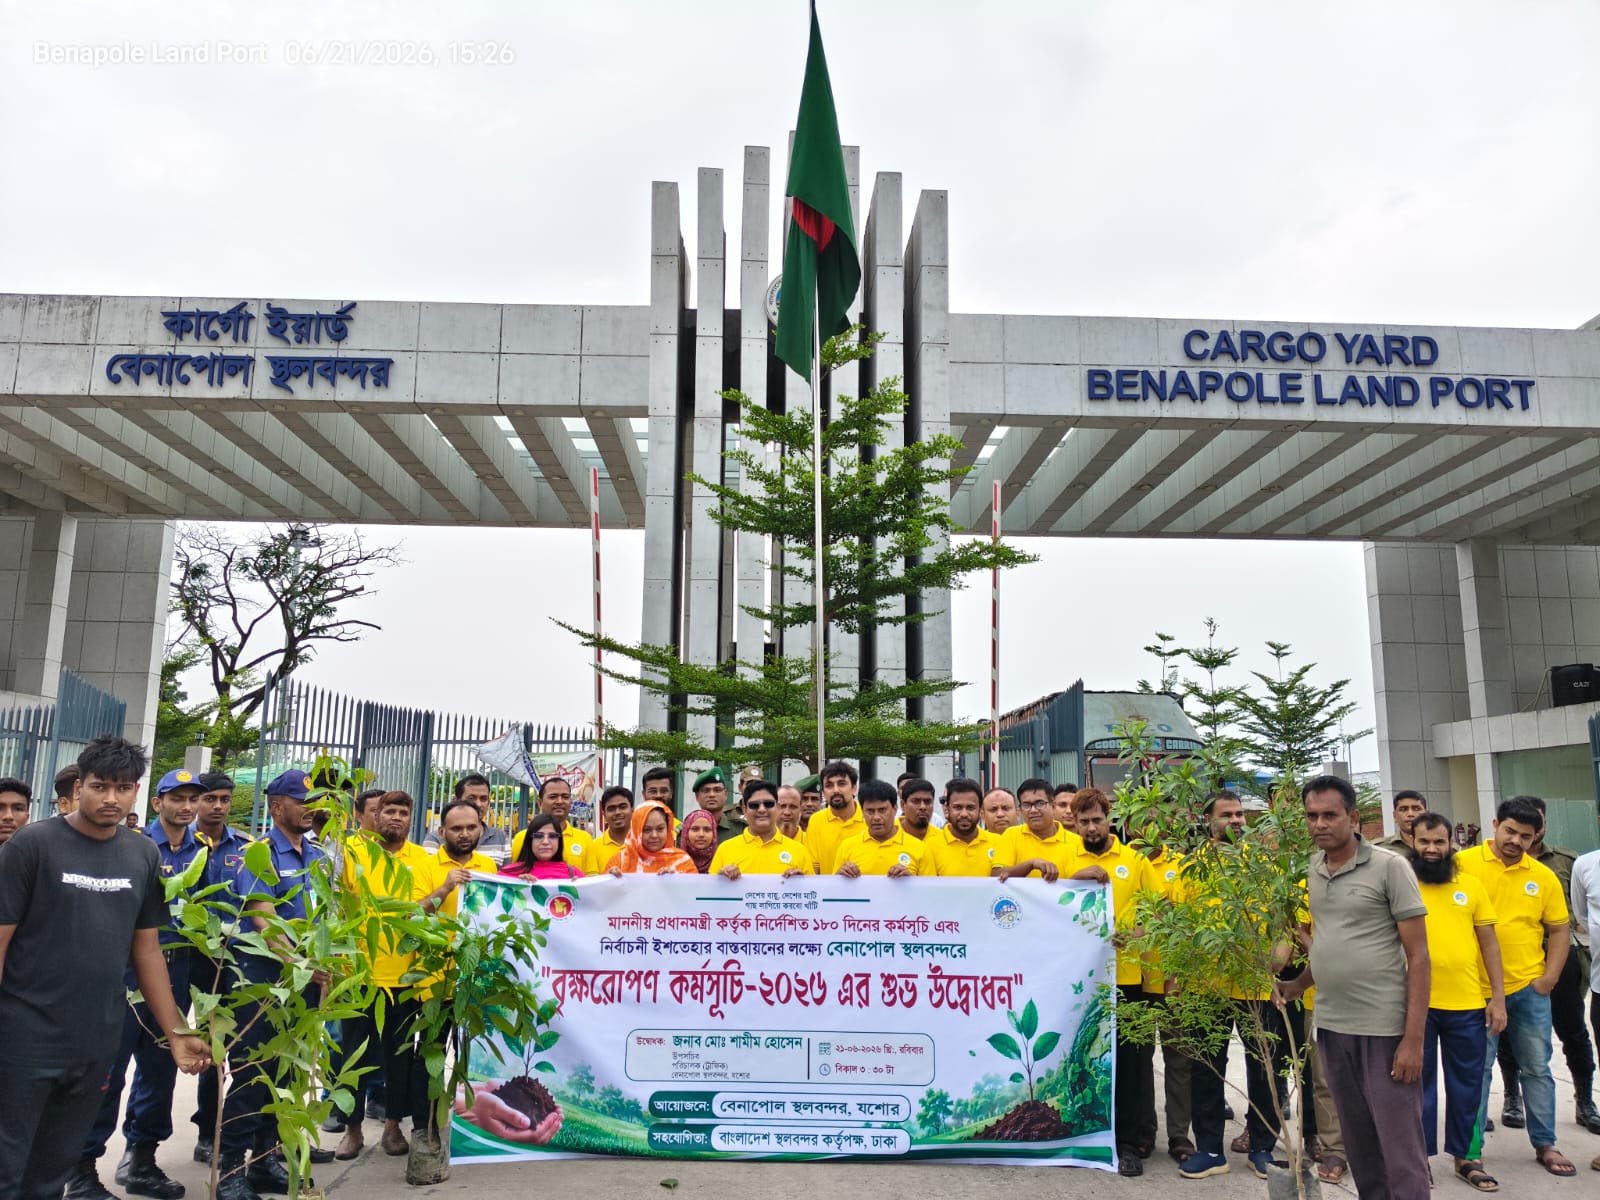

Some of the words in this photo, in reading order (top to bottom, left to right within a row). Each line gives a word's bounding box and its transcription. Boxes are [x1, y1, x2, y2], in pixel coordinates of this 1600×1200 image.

[161, 302, 255, 343] কার্গো
[264, 302, 356, 344] ইয়ার্ড
[1184, 329, 1326, 362] CARGO
[1334, 332, 1438, 366] YARD
[106, 352, 255, 387] বেনাপোল
[265, 356, 394, 394] স্থলবন্দর
[1087, 369, 1304, 404] BENAPOLE
[1315, 374, 1420, 407] LAND
[1430, 376, 1535, 410] PORT
[608, 912, 652, 930] মাননীয়
[656, 912, 712, 931] প্রধানমন্ত্রী
[716, 913, 752, 935] কর্তৃক
[755, 913, 809, 932] নির্দেশিত
[813, 919, 838, 931] ১৮০
[843, 915, 880, 933] দিনের
[884, 915, 929, 938] কর্মসূচি
[934, 919, 960, 934] এবং
[600, 936, 648, 955] নির্বাচনী
[652, 936, 712, 955] ইশতেহার
[716, 941, 784, 956] বাস্তবায়নের
[788, 942, 822, 956] লক্ষ্যে
[827, 940, 895, 957] বেনাপোল
[900, 942, 967, 960] স্থলবন্দরে
[542, 966, 660, 1017] "বৃক্ষরোপণ
[669, 958, 827, 1020] কর্মসূচি-২০২৬
[838, 972, 871, 1009] এর
[880, 972, 918, 1008] শুভ
[672, 1034, 702, 1048] জনাব
[705, 1035, 726, 1048] মোঃ
[729, 1032, 761, 1049] শামীম
[765, 1036, 803, 1049] হোসেন
[899, 1043, 924, 1056] রবিবার
[654, 1100, 709, 1113] আয়োজনে:
[720, 1099, 785, 1115] বেনাপোল
[791, 1101, 852, 1117] স্থলবন্দর,
[857, 1102, 900, 1116] যশোর
[653, 1129, 708, 1146] সহযোগিতা:
[719, 1130, 770, 1147] বাংলাদেশ
[774, 1133, 818, 1148] স্থলবন্দর
[872, 1133, 897, 1149] ঢাকা
